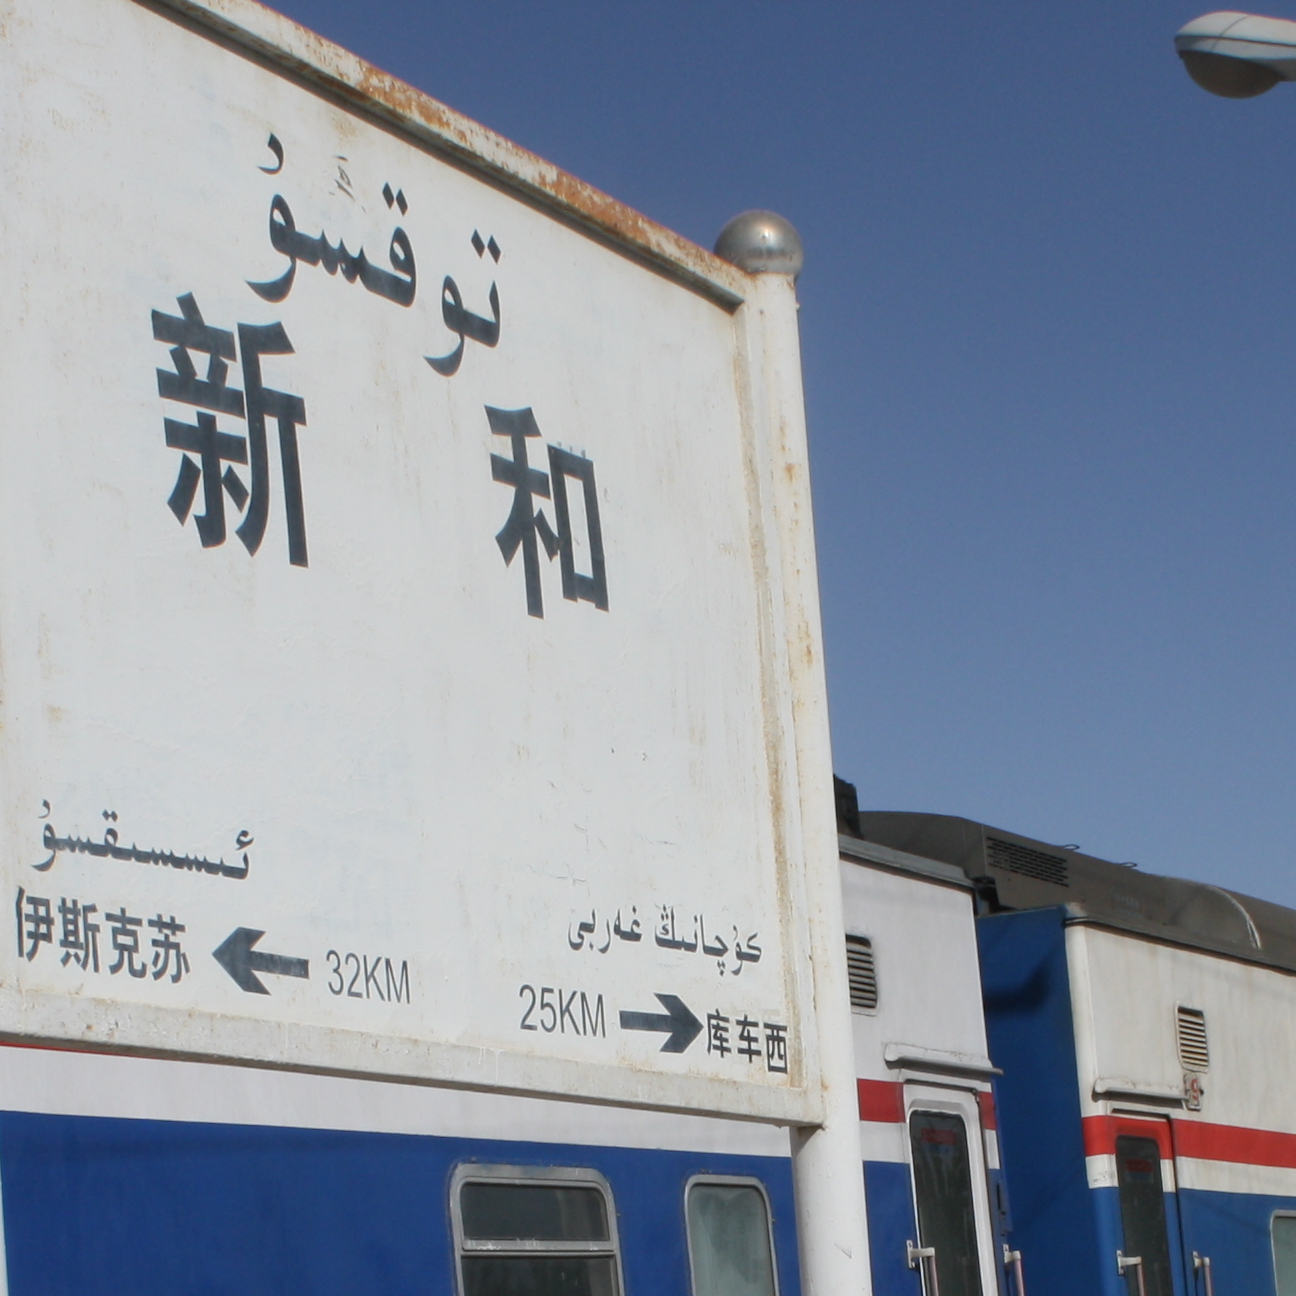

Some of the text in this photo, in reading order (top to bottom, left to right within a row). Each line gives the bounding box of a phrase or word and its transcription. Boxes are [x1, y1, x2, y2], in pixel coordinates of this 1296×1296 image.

[150, 291, 611, 620] 新和
[15, 885, 411, 1005] 伊斯克苏 32KM
[518, 983, 789, 1075] 25KM 库车西
